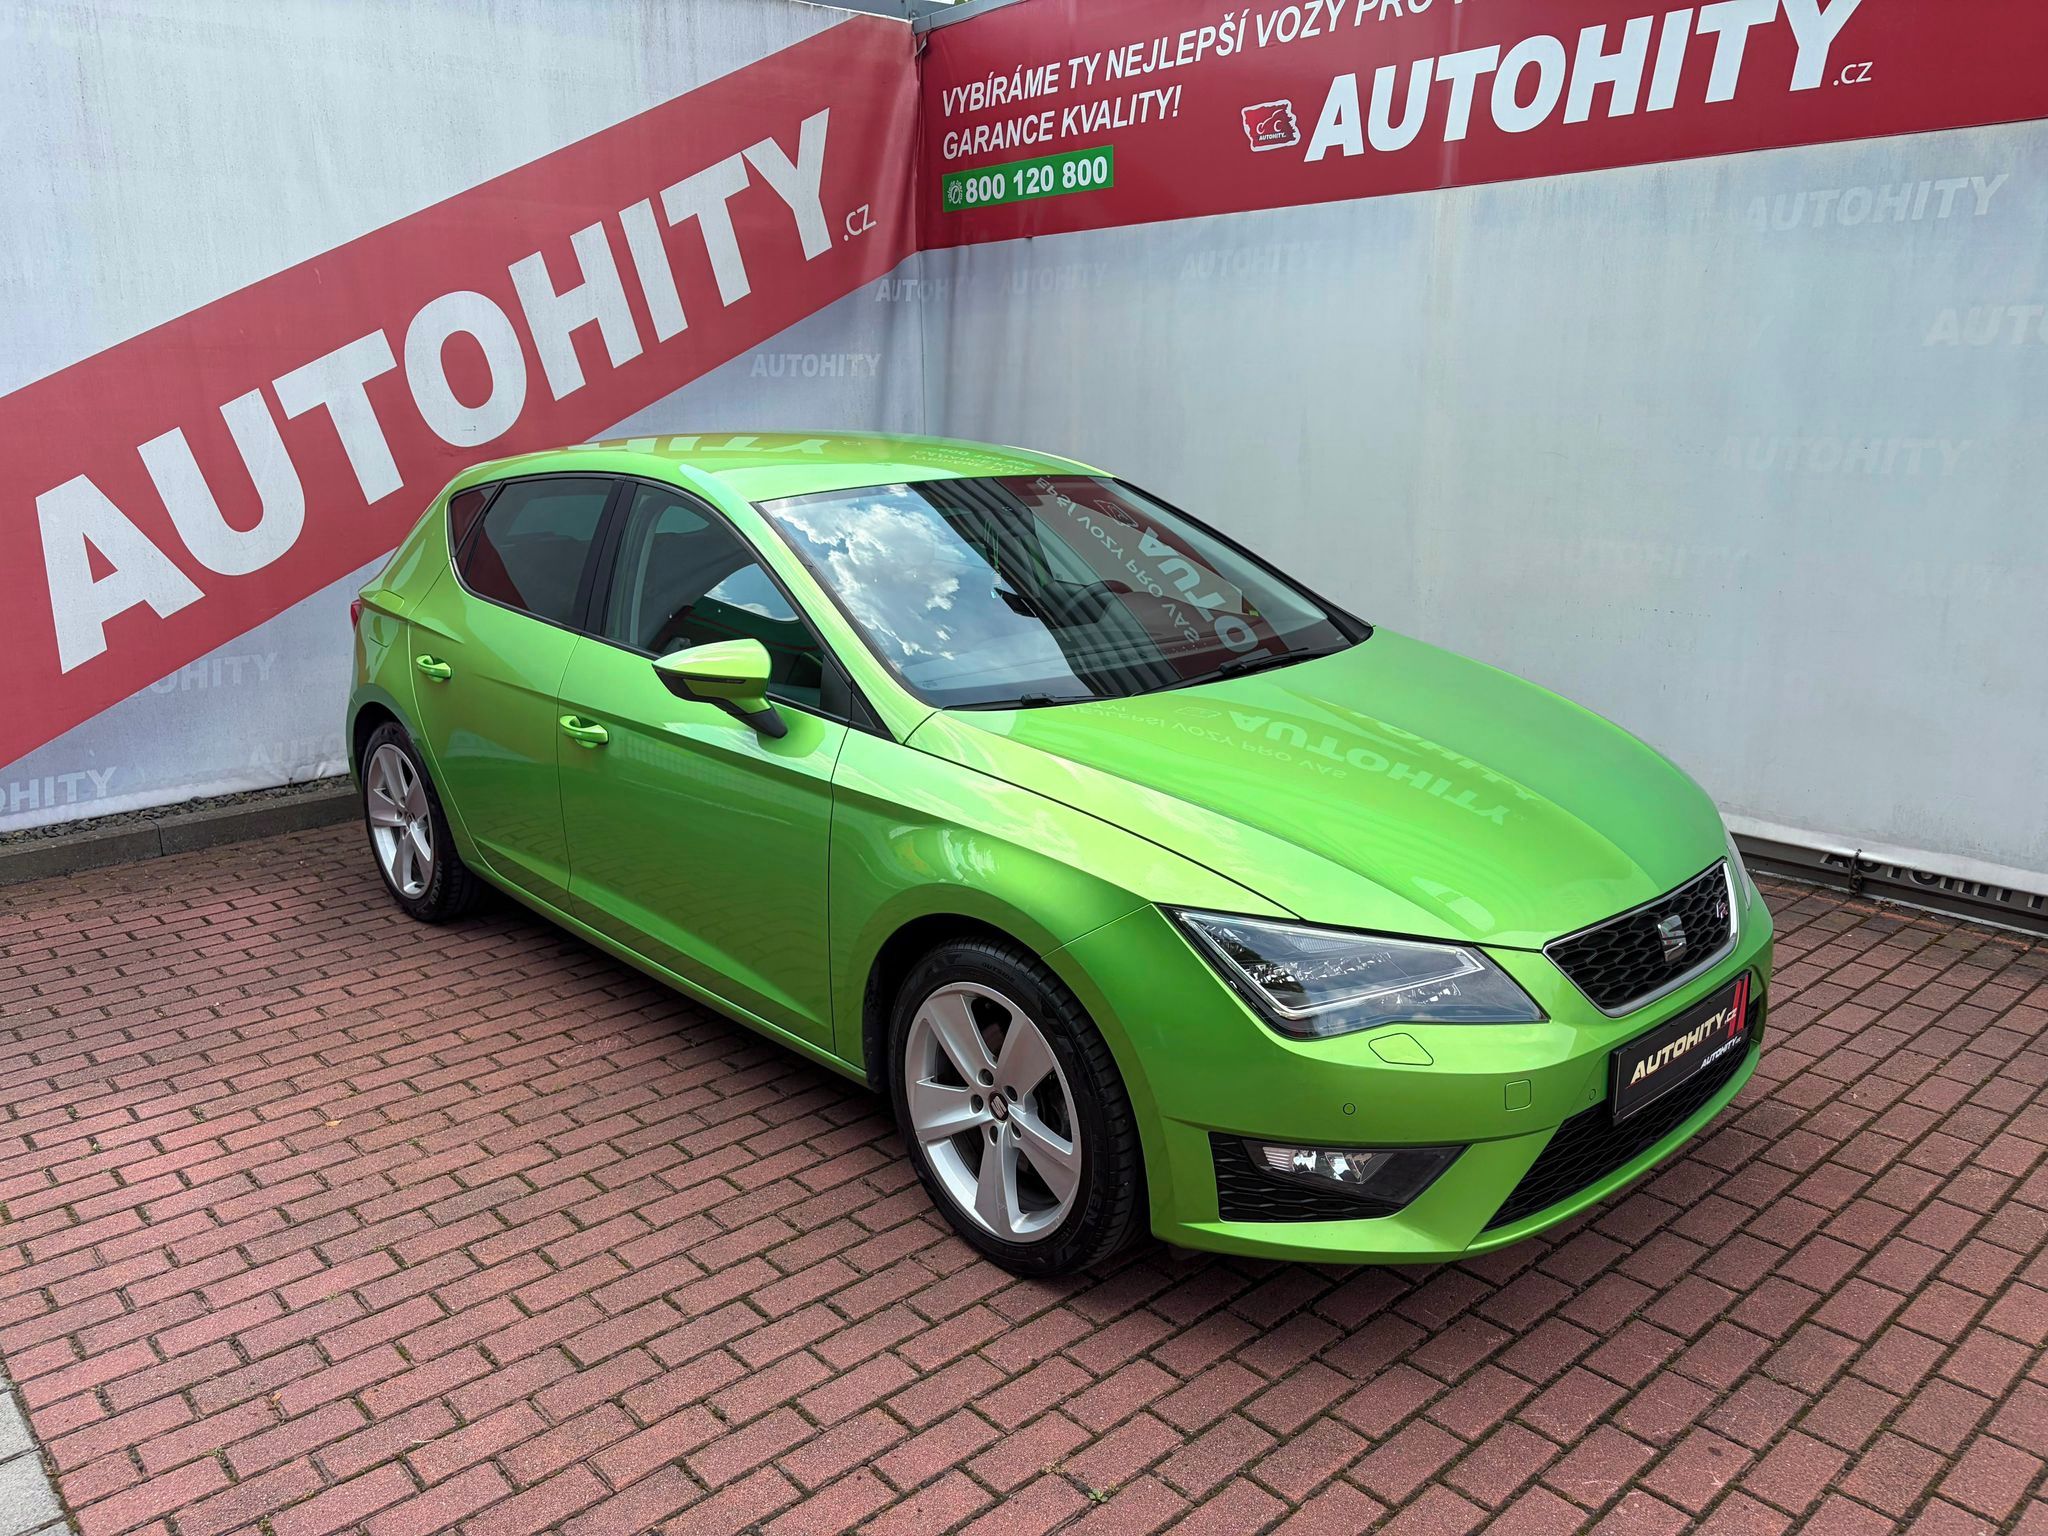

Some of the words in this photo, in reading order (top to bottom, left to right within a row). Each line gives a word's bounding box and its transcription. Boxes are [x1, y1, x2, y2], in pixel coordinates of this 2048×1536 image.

[942, 62, 1060, 117] VYBÍRÁME
[1068, 52, 1101, 89] TY
[1105, 8, 1250, 82] NEJLEPŠÍ
[1256, 0, 1345, 48] VOZY
[943, 110, 1055, 160] GARANCE
[1060, 84, 1182, 138] KVALITY!
[965, 173, 1006, 204] 800
[1013, 165, 1054, 196] 120
[1062, 156, 1108, 189] 800
[1744, 174, 2010, 233] AUTOHITY
[750, 352, 881, 378] AUTOHITY
